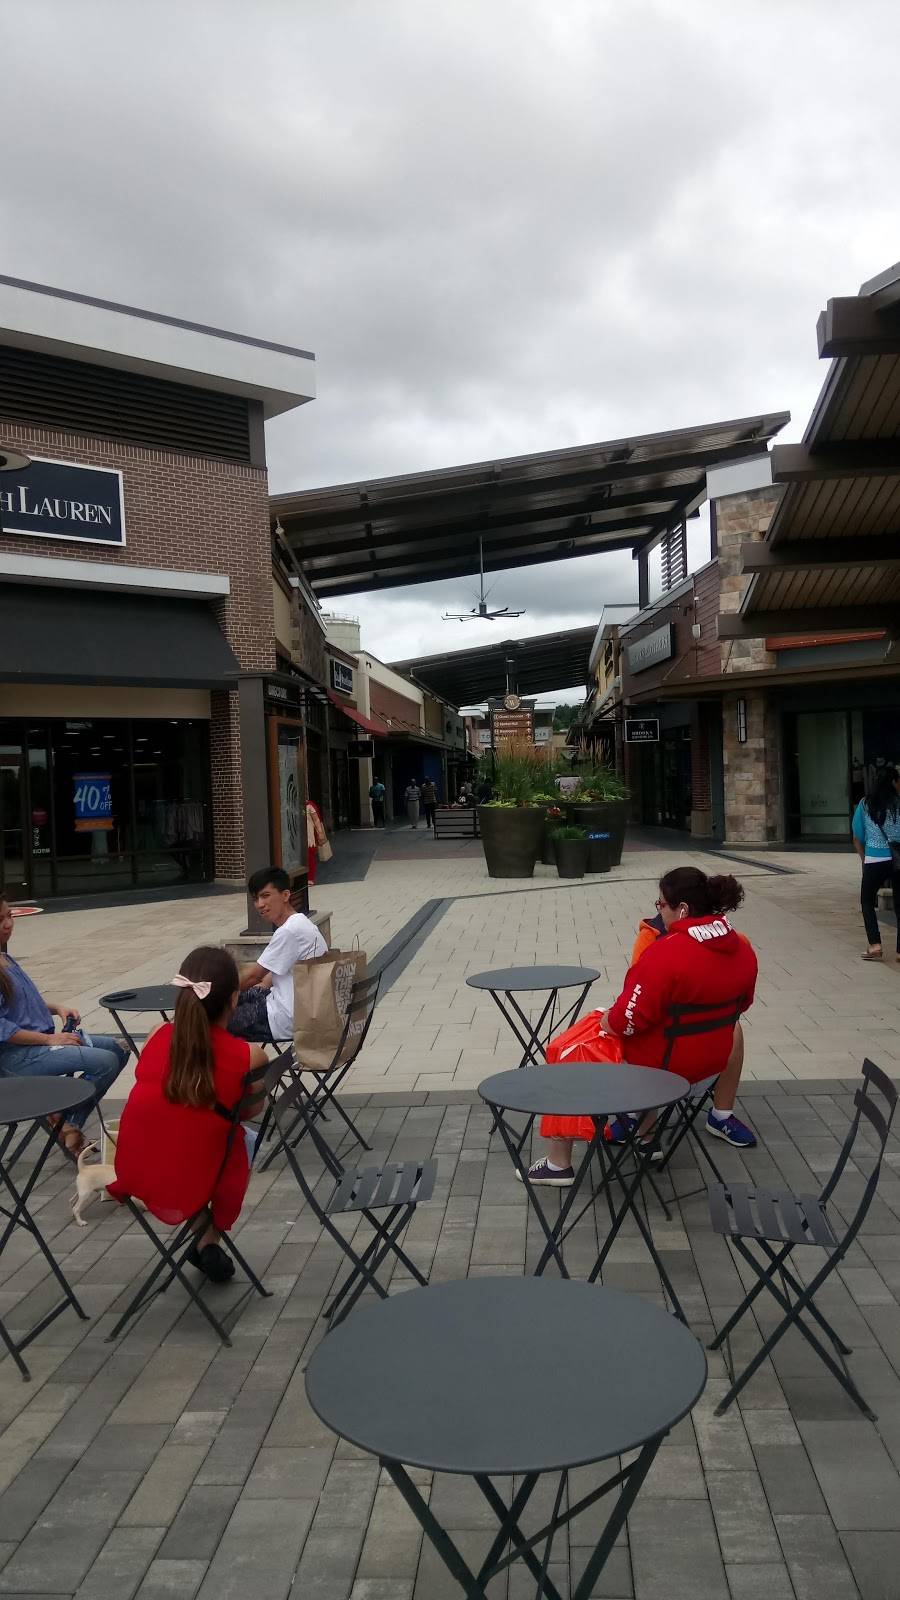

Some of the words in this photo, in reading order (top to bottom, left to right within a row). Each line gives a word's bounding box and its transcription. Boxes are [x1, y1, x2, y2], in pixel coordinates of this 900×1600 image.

[17, 485, 112, 525] LAUREN
[73, 785, 101, 812] 40
[100, 801, 113, 811] OFF
[335, 962, 357, 977] ONLY
